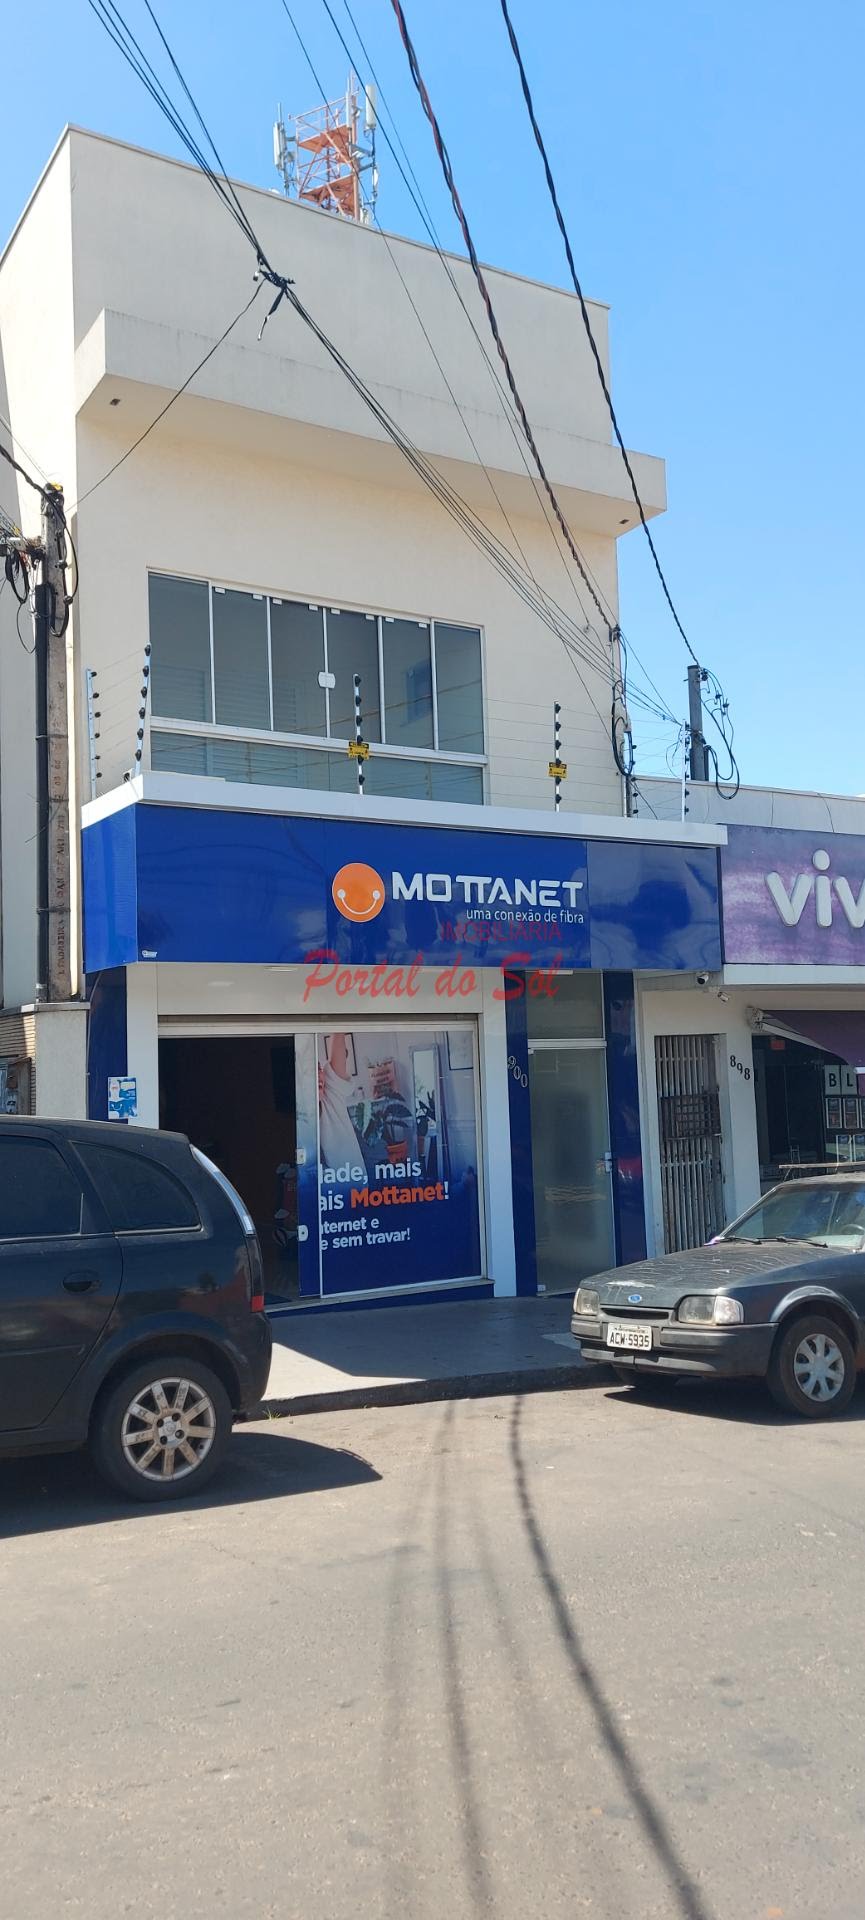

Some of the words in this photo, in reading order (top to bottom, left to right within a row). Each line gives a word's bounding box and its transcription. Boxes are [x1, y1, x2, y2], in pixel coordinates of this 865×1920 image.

[392, 871, 584, 908] MOTTANET
[466, 909, 492, 921] uma
[494, 909, 541, 922] conexão
[543, 910, 558, 923] de
[559, 910, 585, 924] fibra
[507, 1055, 529, 1088] 900
[730, 1055, 751, 1081] 898
[375, 1157, 422, 1180] mais
[351, 1181, 449, 1208] Mottanet!
[370, 1218, 380, 1229] e
[332, 1235, 363, 1249] sem
[366, 1227, 411, 1245] travar!
